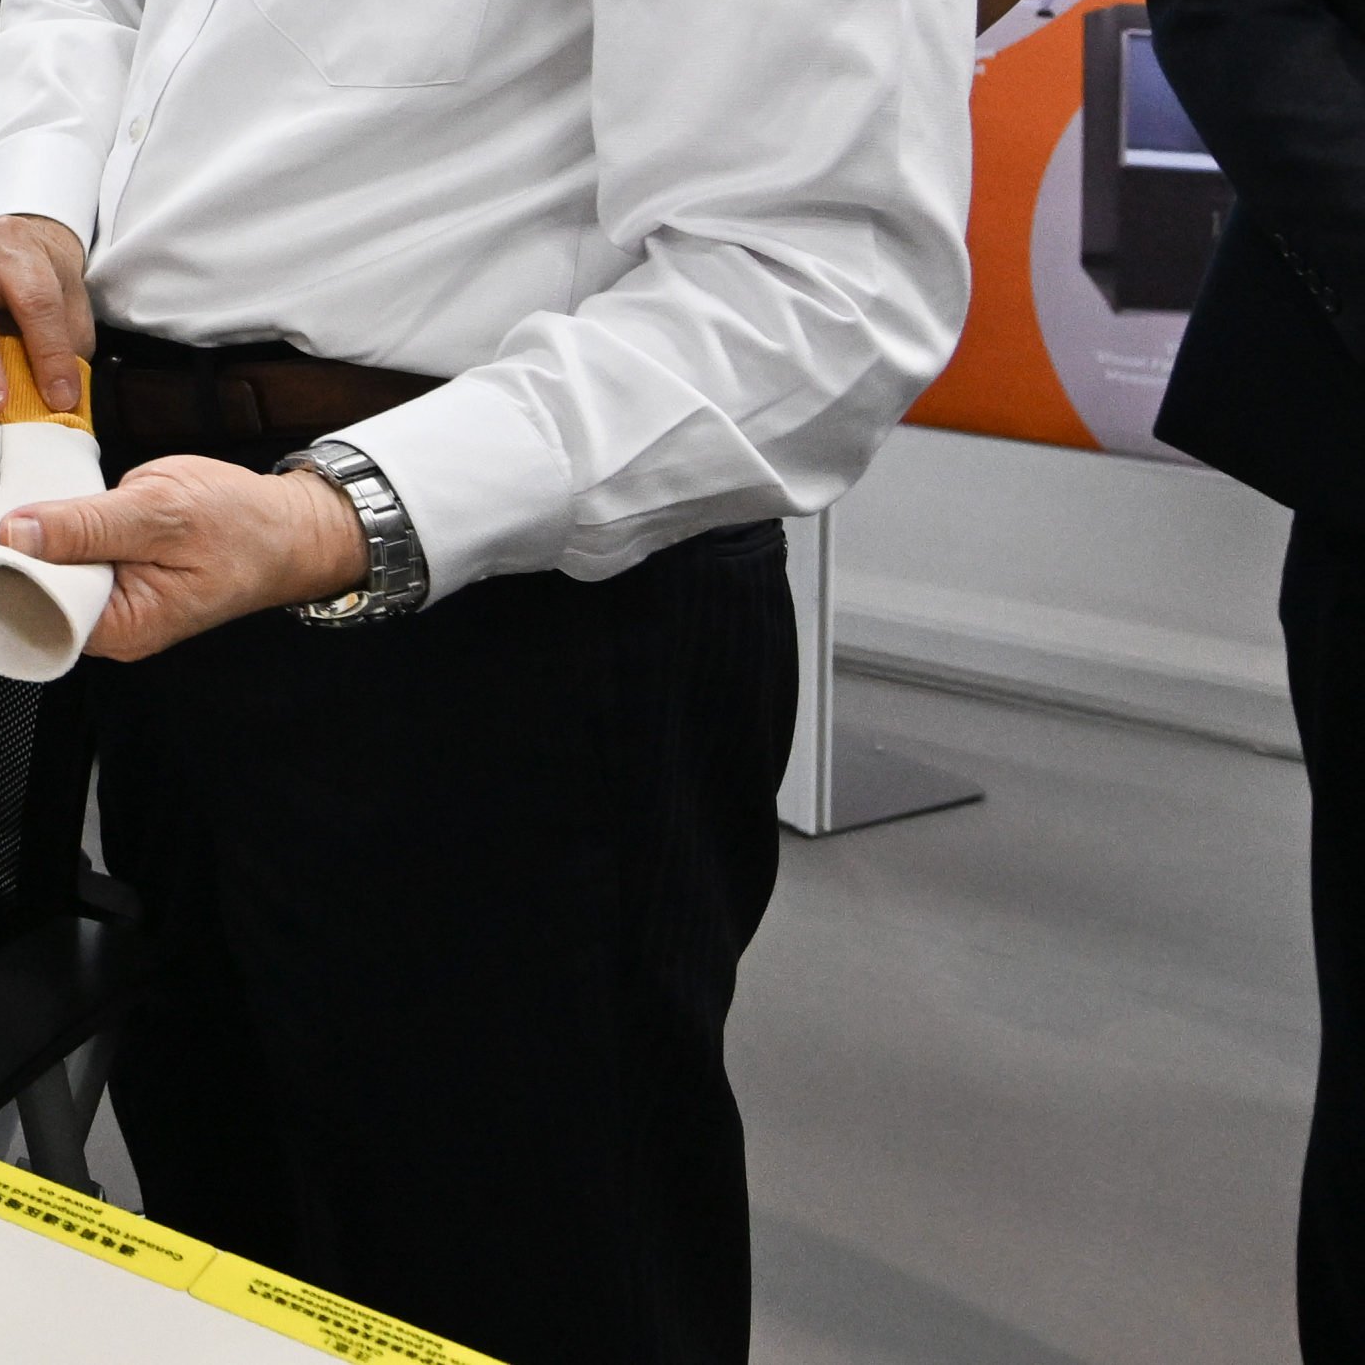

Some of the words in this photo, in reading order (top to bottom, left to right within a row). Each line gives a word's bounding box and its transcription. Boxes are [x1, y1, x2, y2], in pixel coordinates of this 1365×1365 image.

[38, 1186, 55, 1196] on
[11, 1187, 96, 1224] compressed
[59, 1195, 104, 1215] power
[99, 1222, 122, 1235] the
[125, 1232, 183, 1261] Connect
